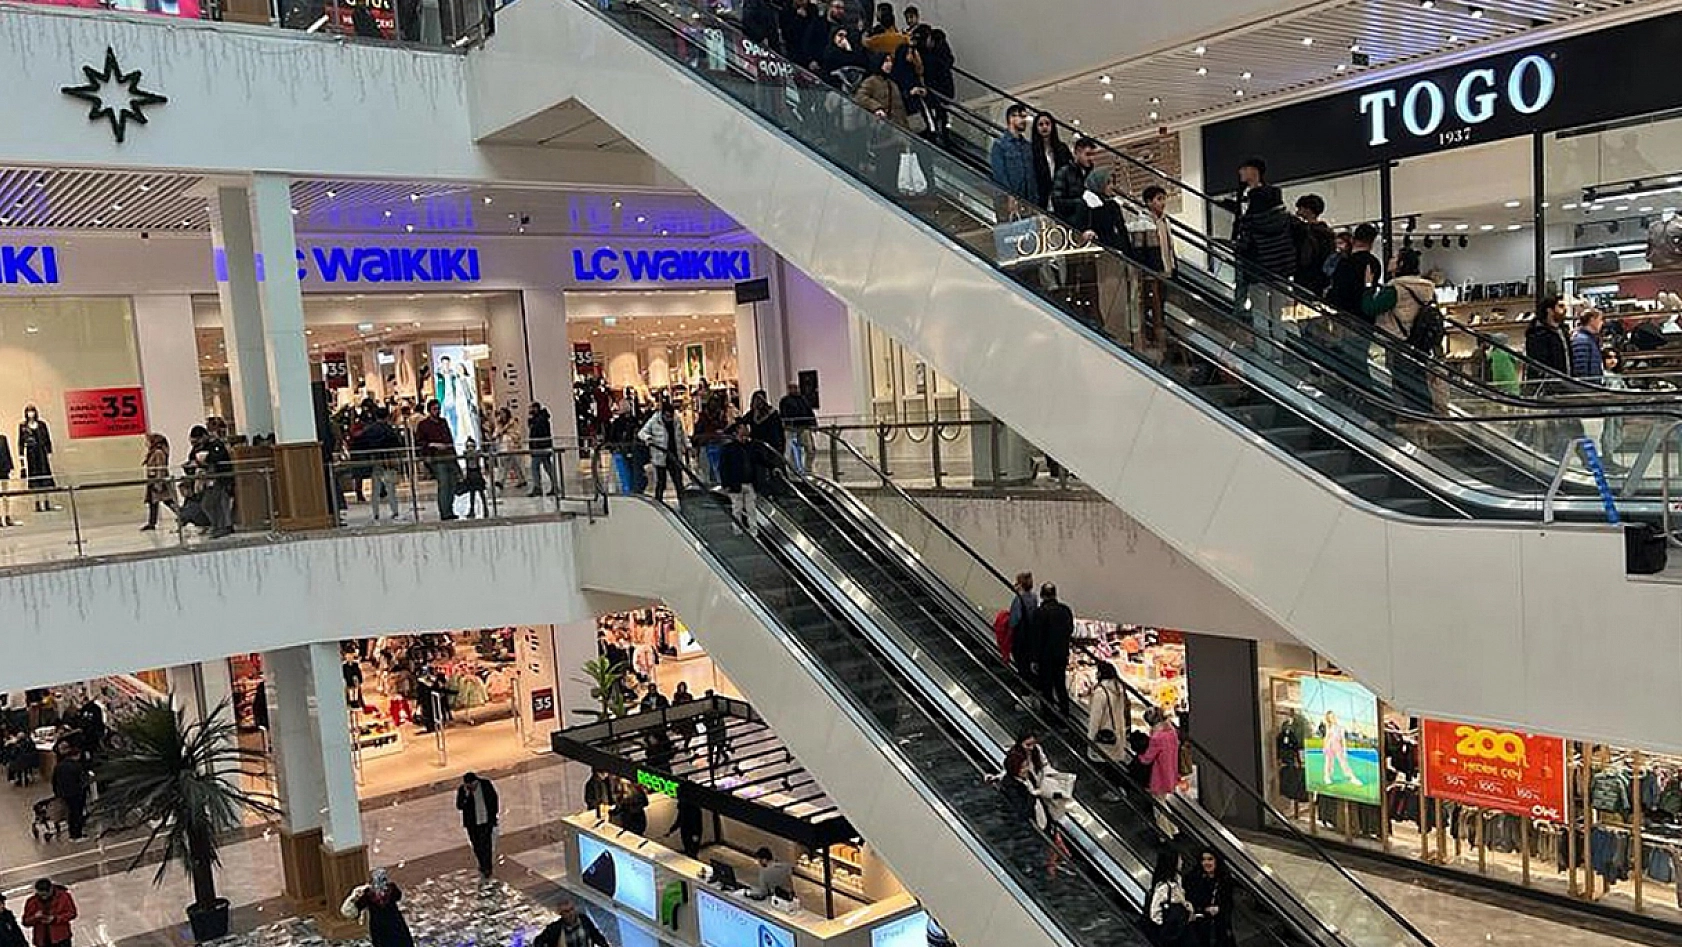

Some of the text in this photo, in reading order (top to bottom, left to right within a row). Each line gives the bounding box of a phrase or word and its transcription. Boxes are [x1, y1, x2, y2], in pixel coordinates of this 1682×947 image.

[1359, 54, 1556, 146] TOGO
[1438, 127, 1472, 145] 1937
[0, 246, 58, 284] KI
[572, 248, 620, 281] LC
[102, 395, 138, 418] 35
[534, 696, 552, 711] 35
[1455, 726, 1526, 762] 200
